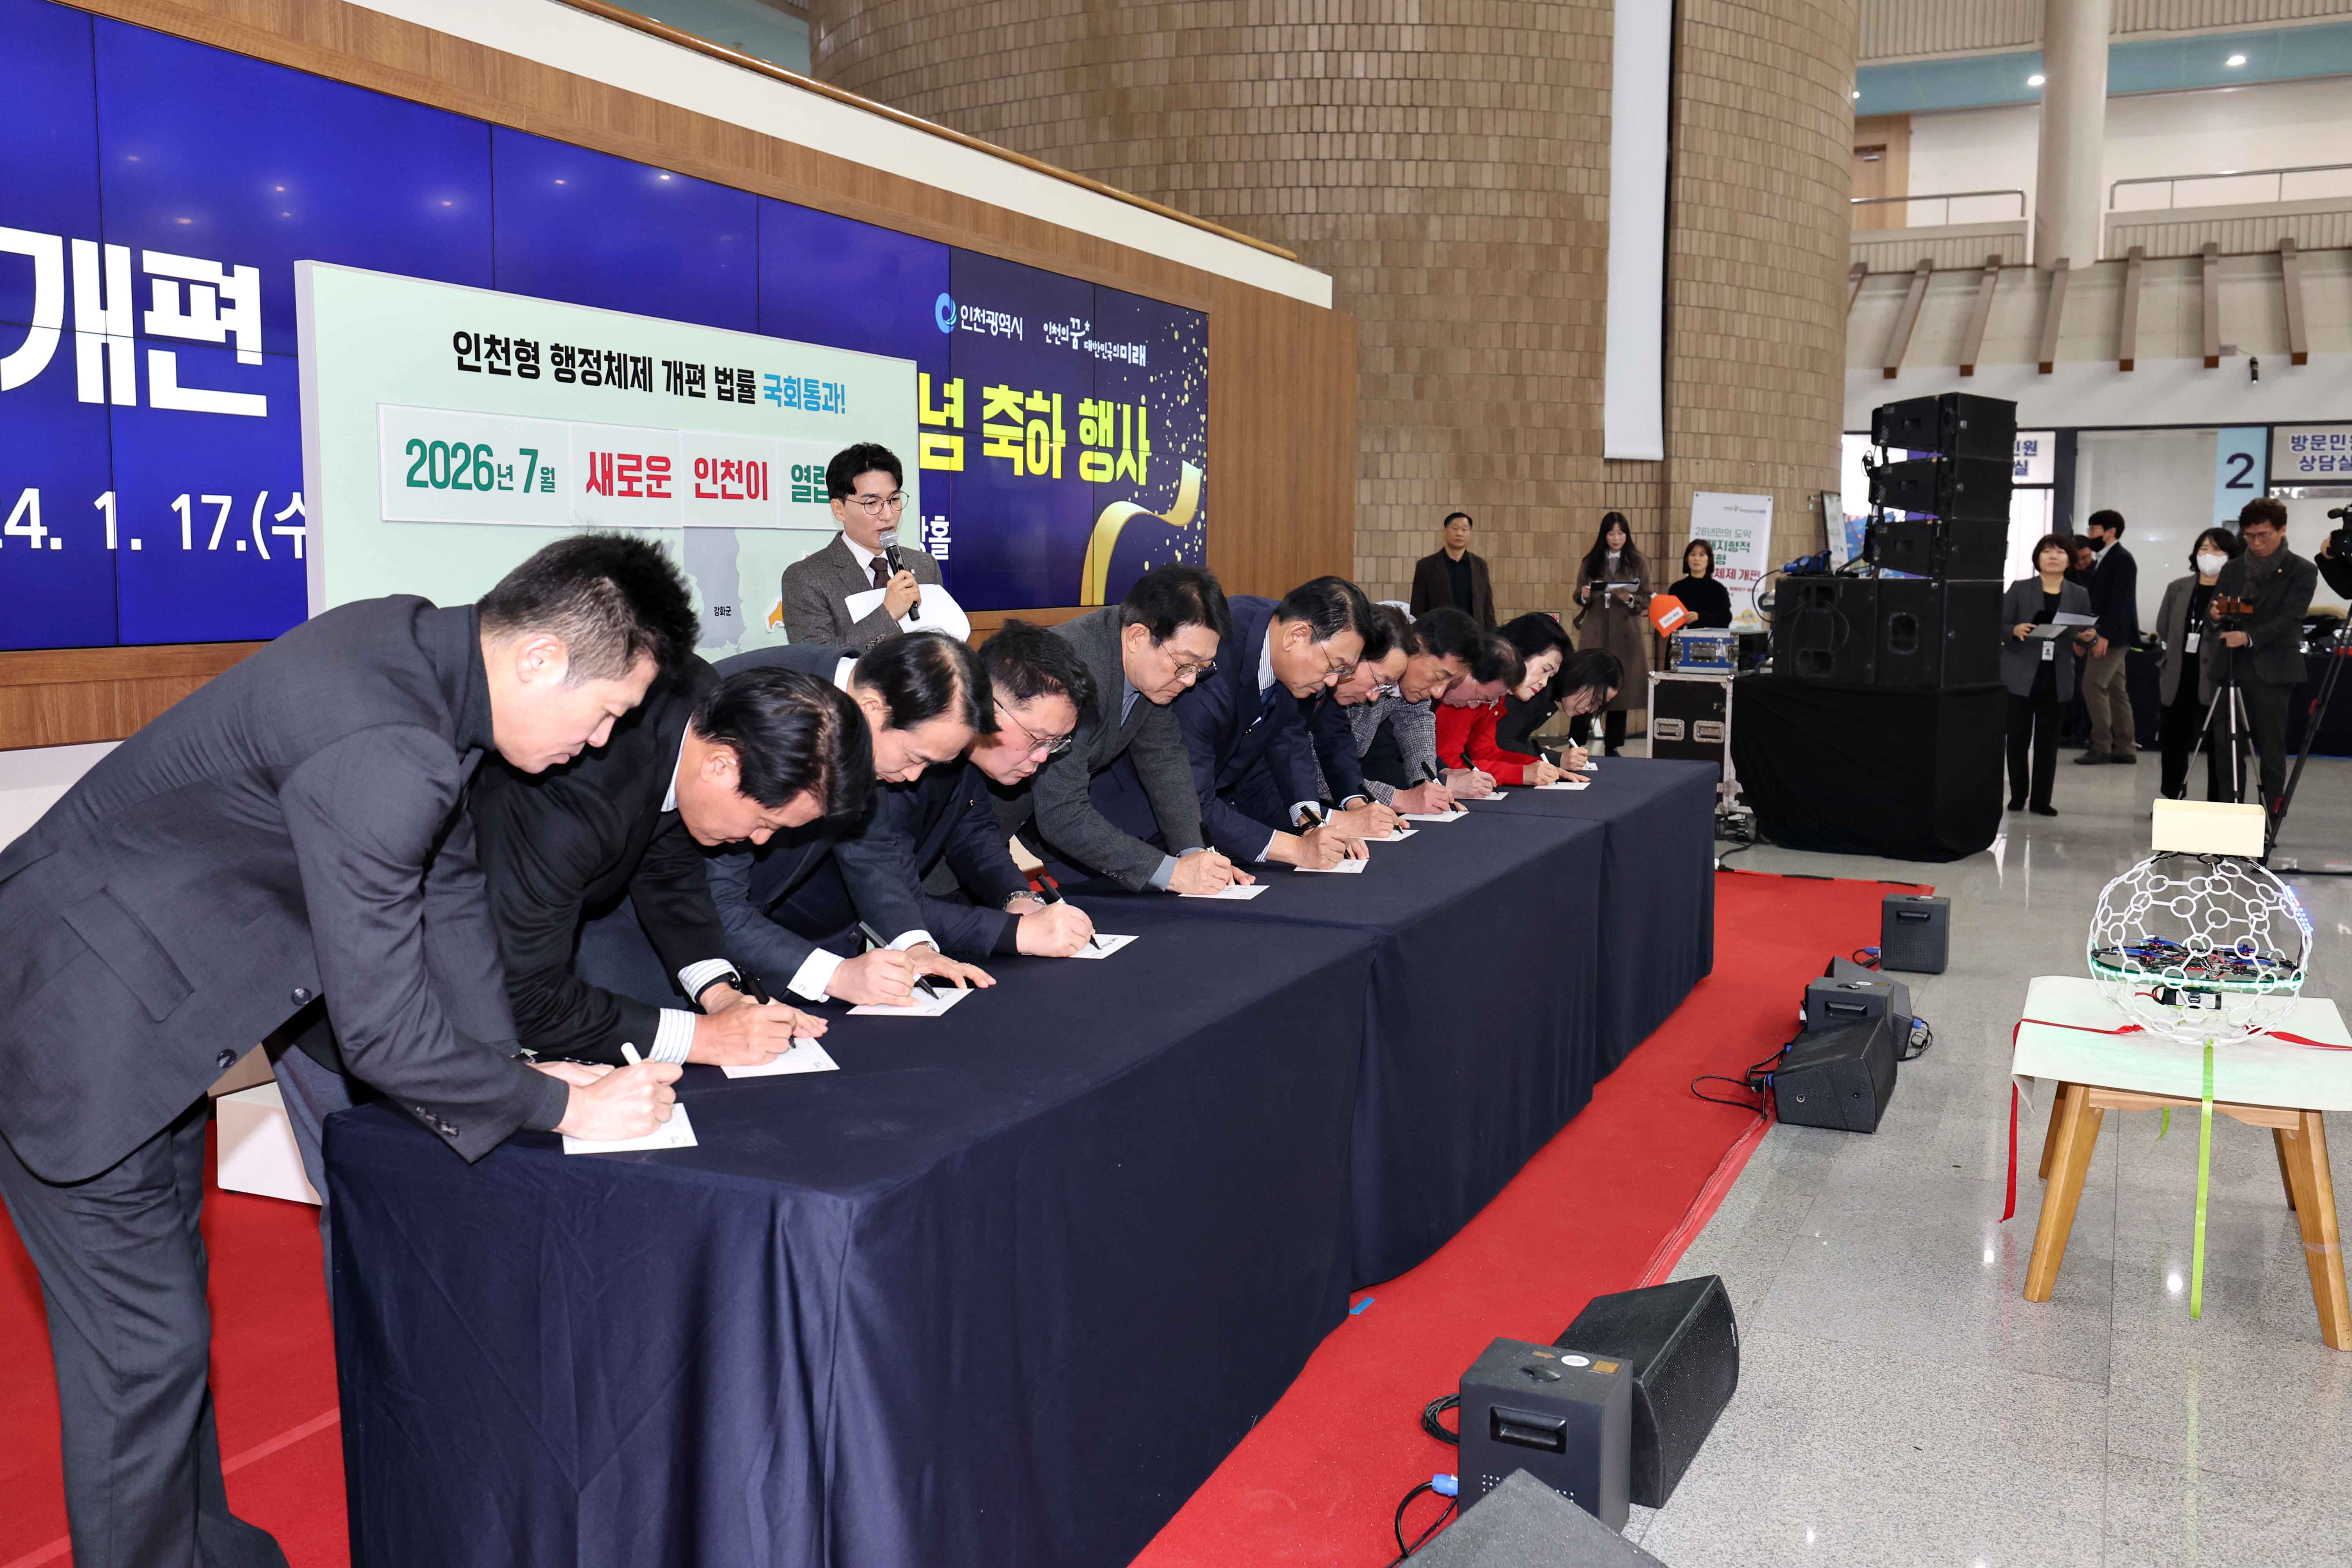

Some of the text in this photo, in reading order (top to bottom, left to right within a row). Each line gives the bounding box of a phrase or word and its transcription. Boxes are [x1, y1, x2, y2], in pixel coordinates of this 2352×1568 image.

[0, 227, 267, 417] 개편
[960, 305, 1023, 341] 인천광역시
[453, 331, 846, 414] 인천형 행정체제 개편 법률 국회통과!
[1120, 342, 1146, 367] 미래
[983, 384, 1066, 479] 축하
[1078, 397, 1152, 486] 행사
[2014, 440, 2037, 457] 원
[2291, 434, 2352, 452] 방문민
[405, 438, 514, 492] 2026년
[519, 448, 555, 493] 7월
[586, 451, 671, 498] 새로운
[695, 457, 768, 501] 인천이
[2225, 453, 2254, 489] 2
[94, 491, 142, 550] 1.
[1695, 526, 1732, 537] 28년만의
[1738, 569, 1761, 581] 개편
[714, 606, 731, 617] 강화군
